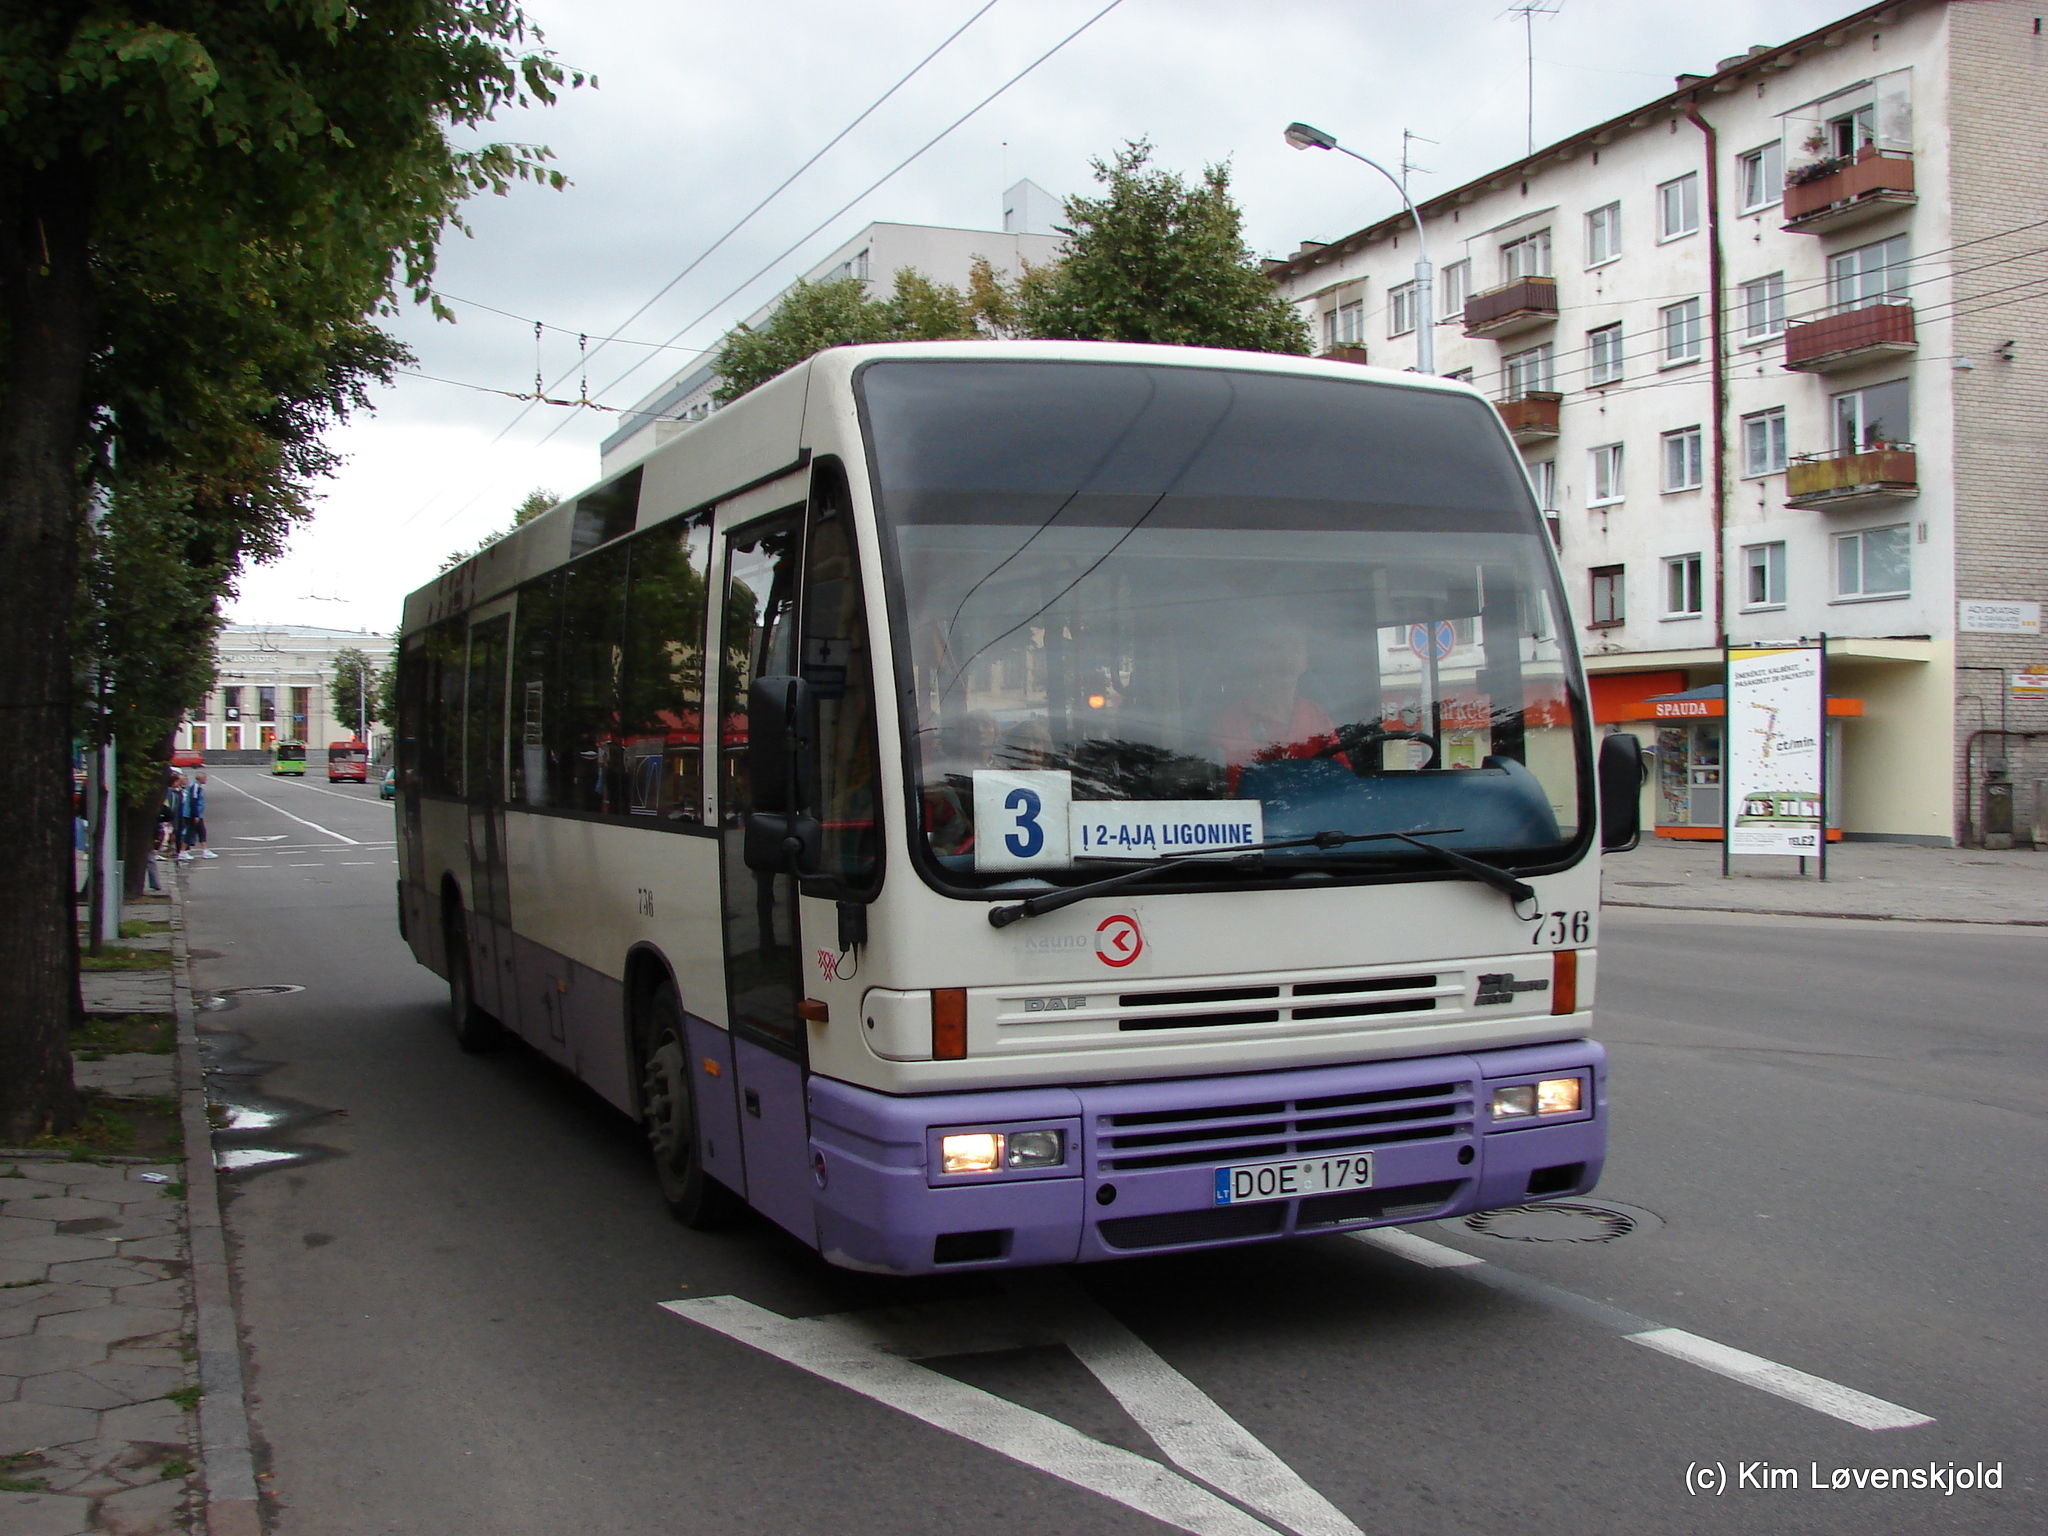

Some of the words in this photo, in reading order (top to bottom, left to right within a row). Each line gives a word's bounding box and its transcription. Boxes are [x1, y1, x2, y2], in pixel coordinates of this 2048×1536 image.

[1656, 702, 1708, 716] SPAUDA
[1004, 787, 1044, 858] 3
[1096, 824, 1156, 850] 2-ĄJĄ
[1787, 835, 1815, 847] TELE2
[638, 888, 654, 917] 736
[1532, 910, 1589, 945] 736
[1025, 931, 1087, 949] Kauno
[1025, 997, 1086, 1012] DAF
[1235, 1164, 1298, 1198] DOE
[1322, 1157, 1369, 1188] 179
[1216, 1189, 1230, 1199] LT
